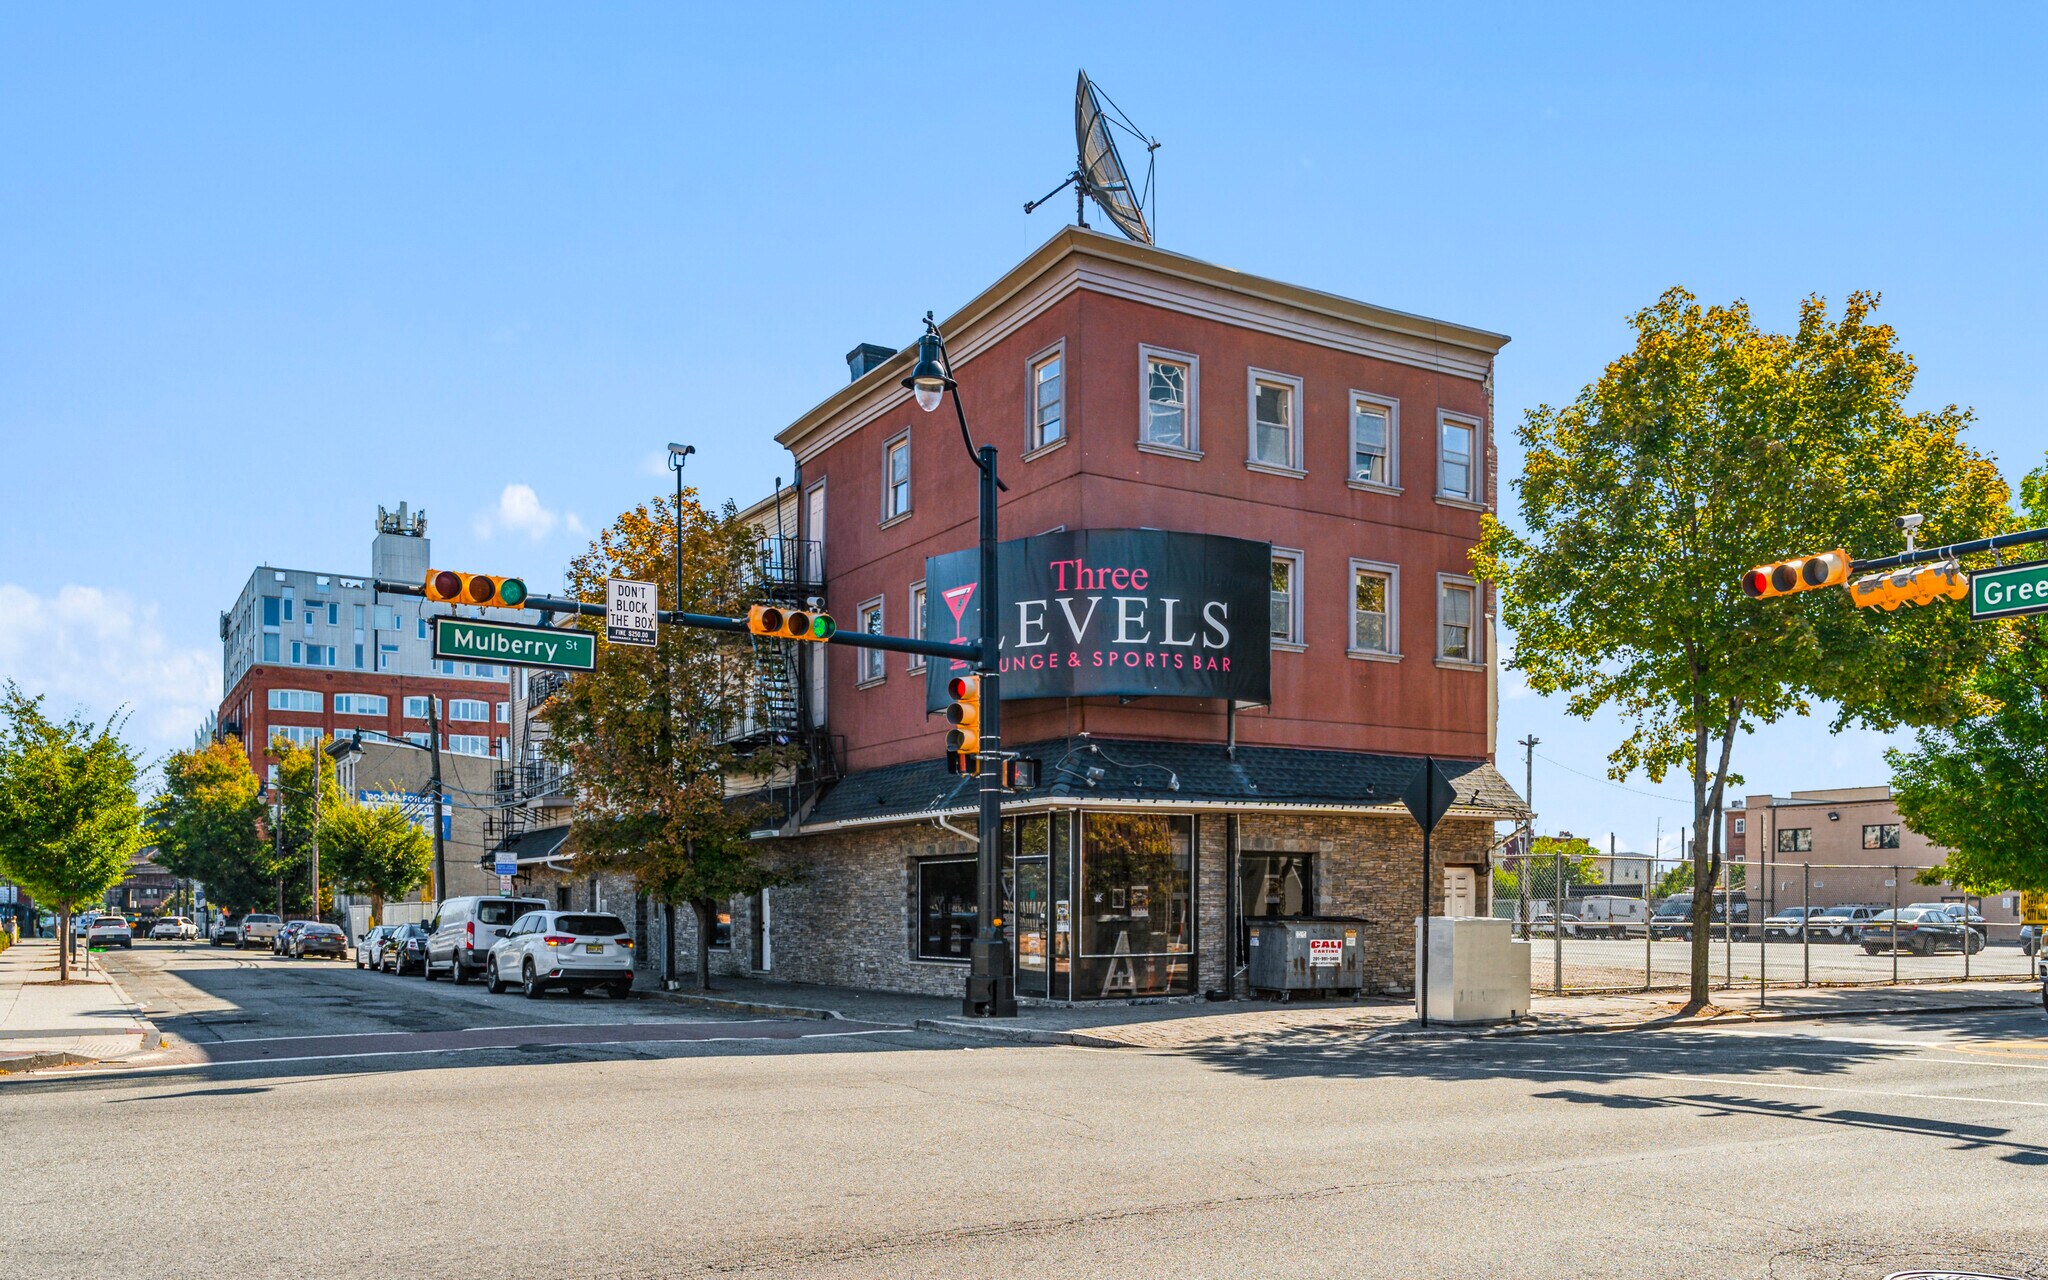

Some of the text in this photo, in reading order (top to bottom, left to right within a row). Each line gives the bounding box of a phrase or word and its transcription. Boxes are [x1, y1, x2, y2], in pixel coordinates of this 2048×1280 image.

[1050, 558, 1149, 592] Three
[618, 584, 646, 599] DON'T
[1984, 580, 2048, 605] Gree
[616, 599, 648, 614] BLOCK
[611, 613, 654, 630] THE BOX
[998, 596, 1230, 650] EVELS
[615, 629, 649, 639] FINE $250.00
[454, 628, 578, 662] Mulberry St
[998, 650, 1232, 673] UNGE & SPORTS BAR
[367, 792, 401, 802] ROOMS
[1310, 940, 1342, 949] CALI
